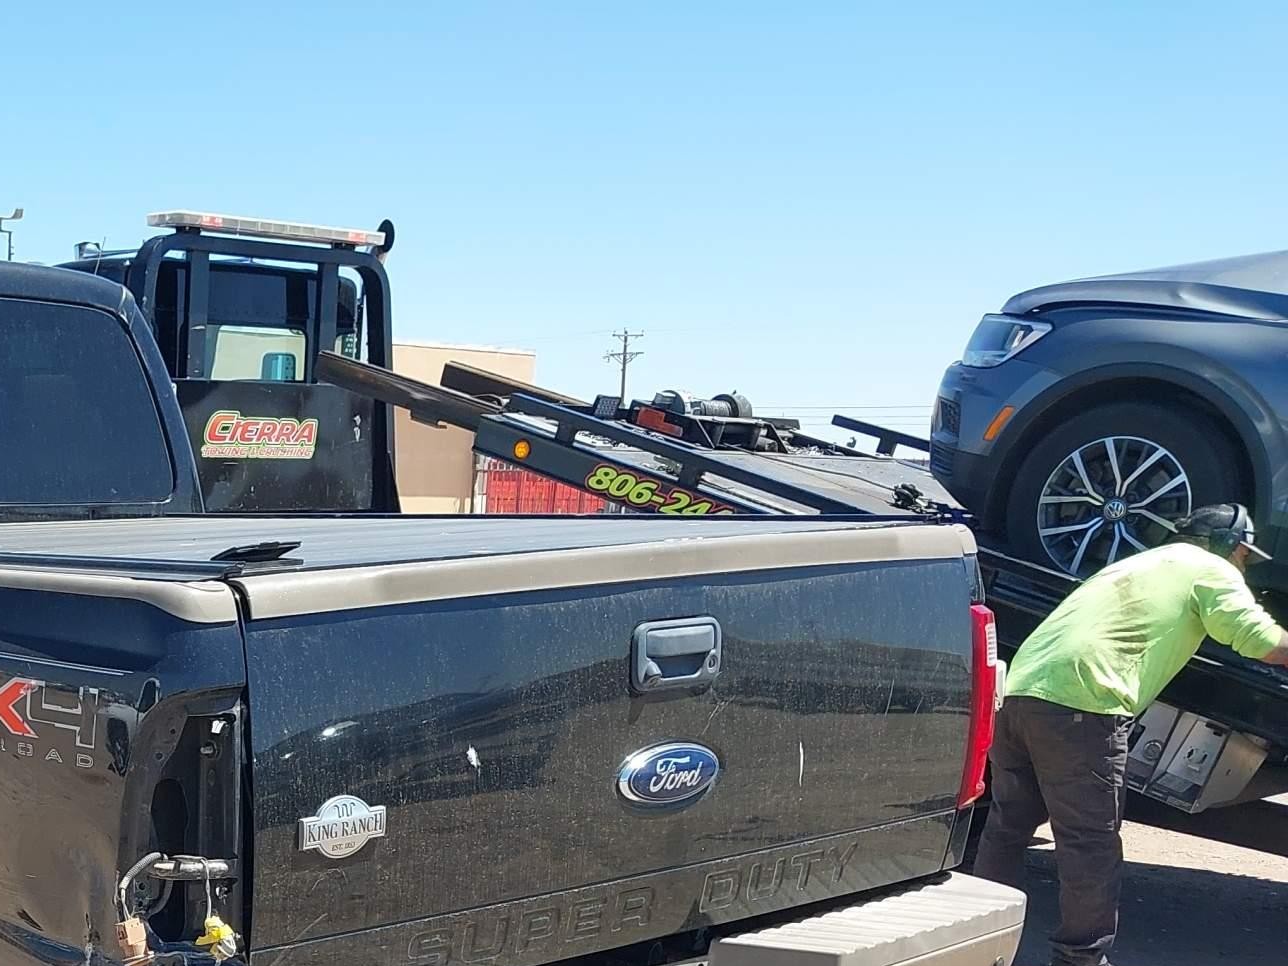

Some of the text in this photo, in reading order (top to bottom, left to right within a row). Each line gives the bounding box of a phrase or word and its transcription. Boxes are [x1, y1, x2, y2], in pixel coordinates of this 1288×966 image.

[649, 755, 704, 793] Ford
[308, 812, 383, 843] KING RANCH
[699, 841, 858, 914] DUTY
